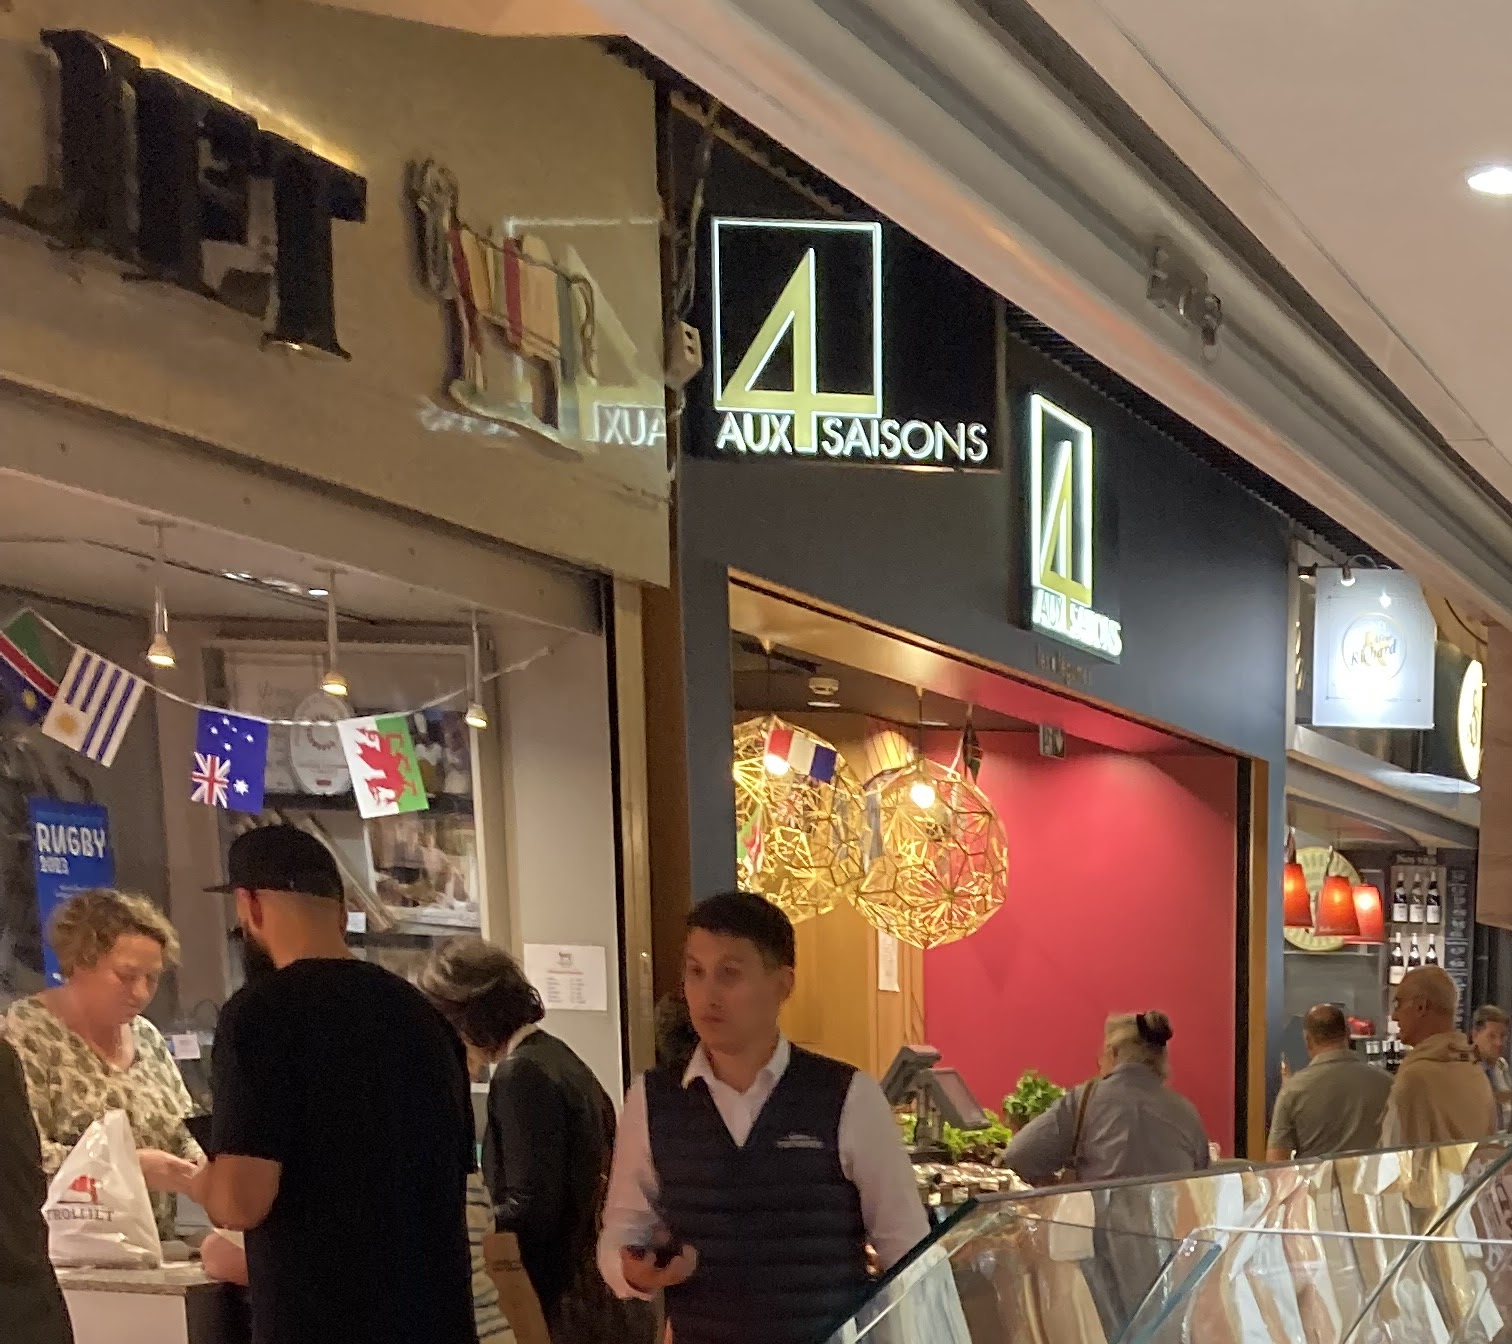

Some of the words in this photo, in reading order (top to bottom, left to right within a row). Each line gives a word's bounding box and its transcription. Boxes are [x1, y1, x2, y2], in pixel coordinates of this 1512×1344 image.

[718, 247, 882, 453] 4
[716, 411, 793, 454] AUX
[821, 416, 989, 464] SAISONS
[36, 821, 107, 859] RUGBY
